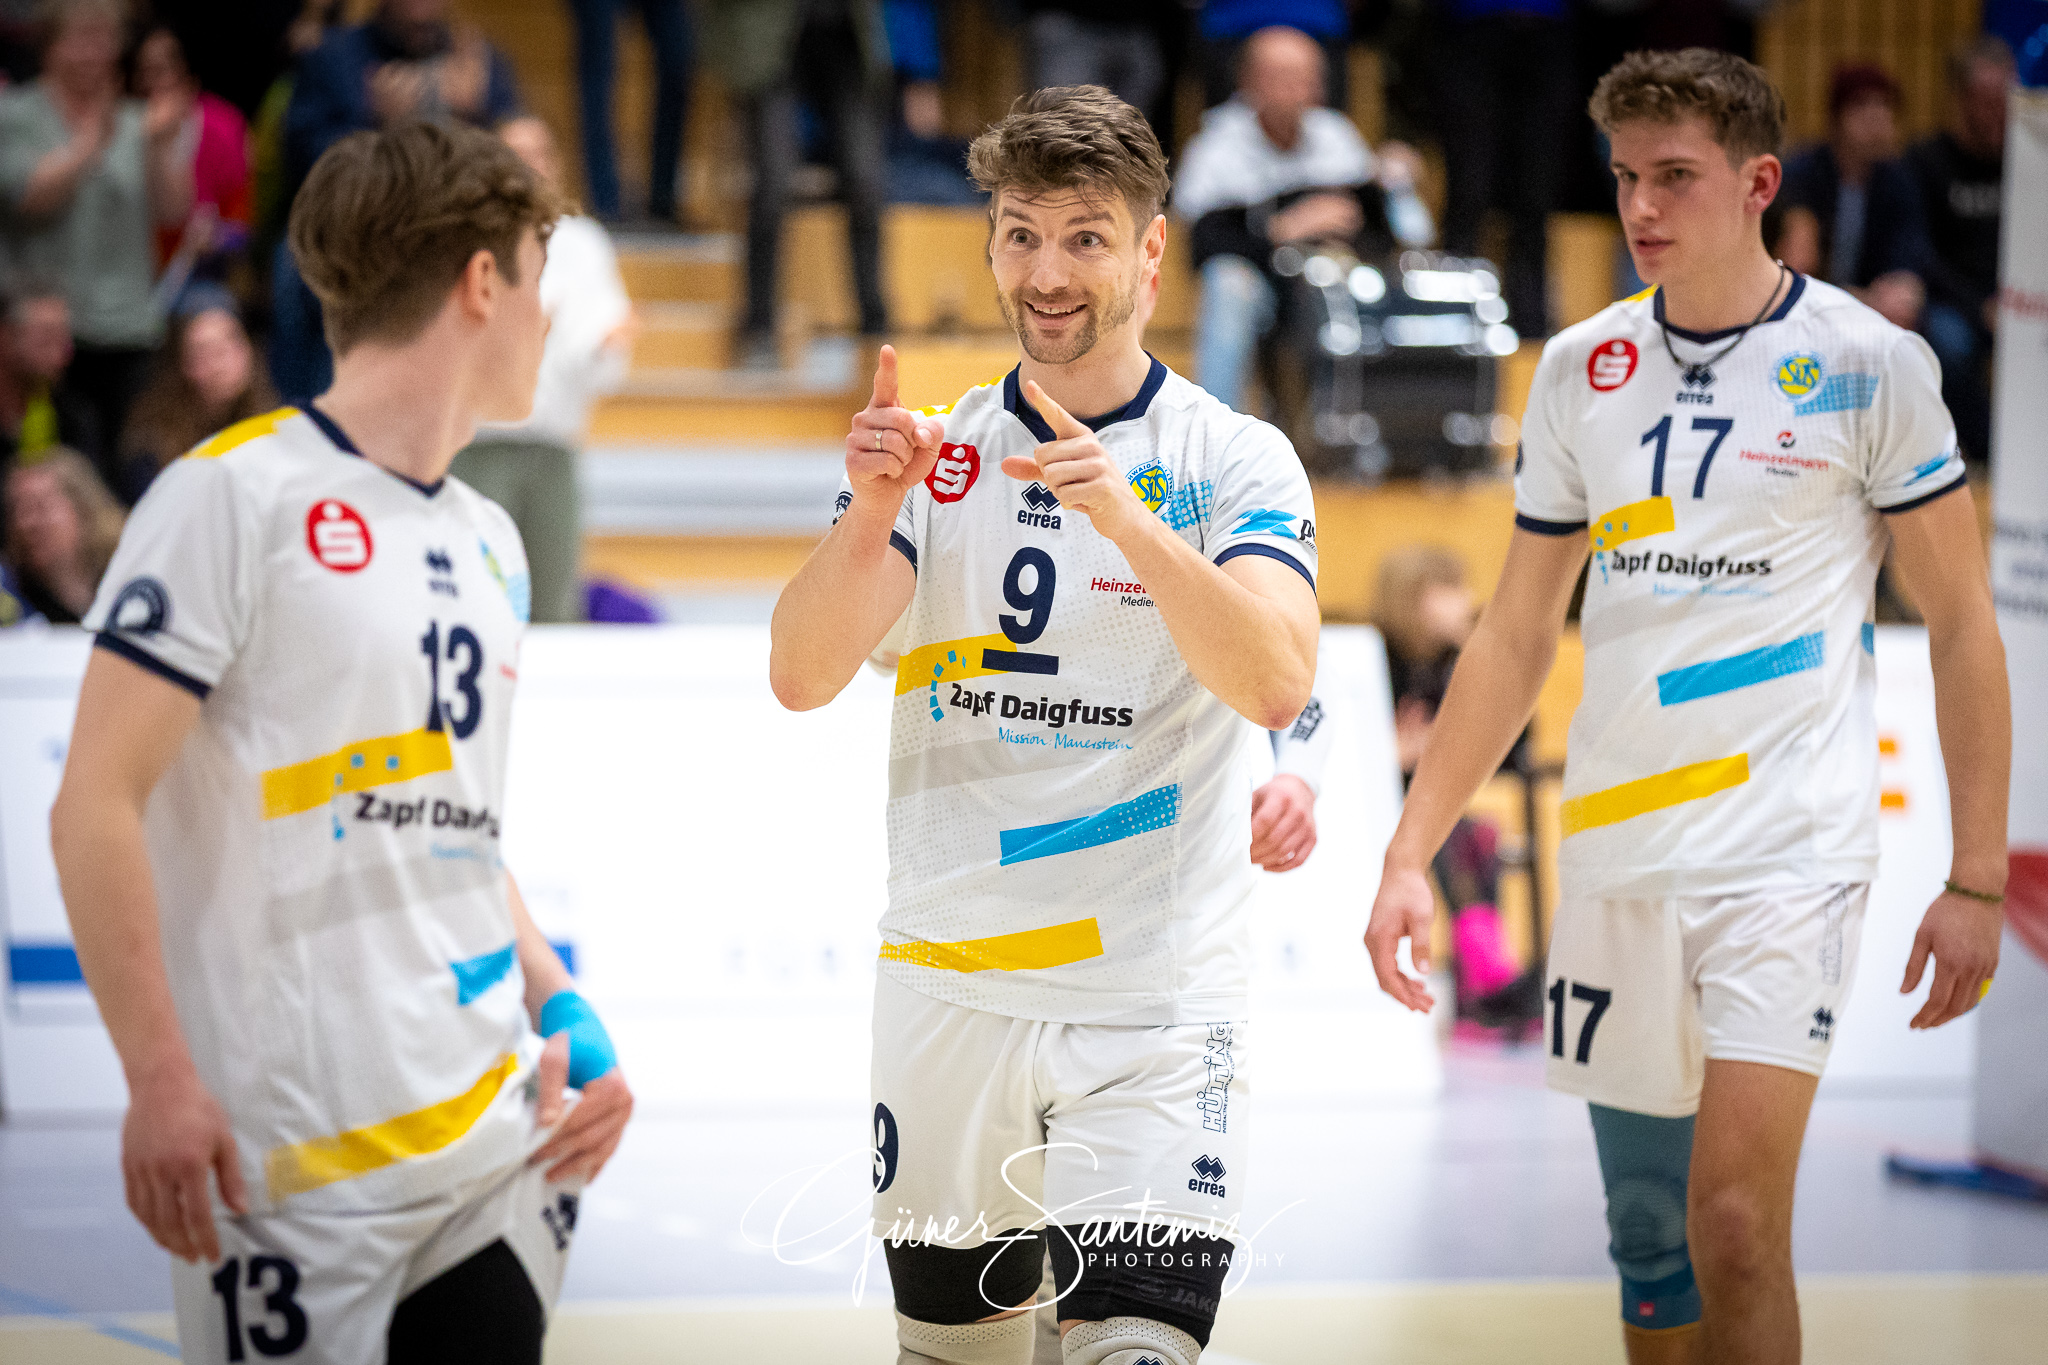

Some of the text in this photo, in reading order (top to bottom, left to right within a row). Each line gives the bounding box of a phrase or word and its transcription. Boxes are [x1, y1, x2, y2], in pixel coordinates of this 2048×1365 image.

[1641, 414, 1734, 499] 17
[1017, 509, 1062, 531] errea
[998, 547, 1057, 645] 9
[1656, 553, 1773, 580] Daigfuss
[420, 618, 484, 741] 13
[949, 682, 1134, 729] Zapf Daigfuss
[1548, 978, 1612, 1065] 17
[1188, 1178, 1226, 1199] errea
[211, 1254, 310, 1363] 13
